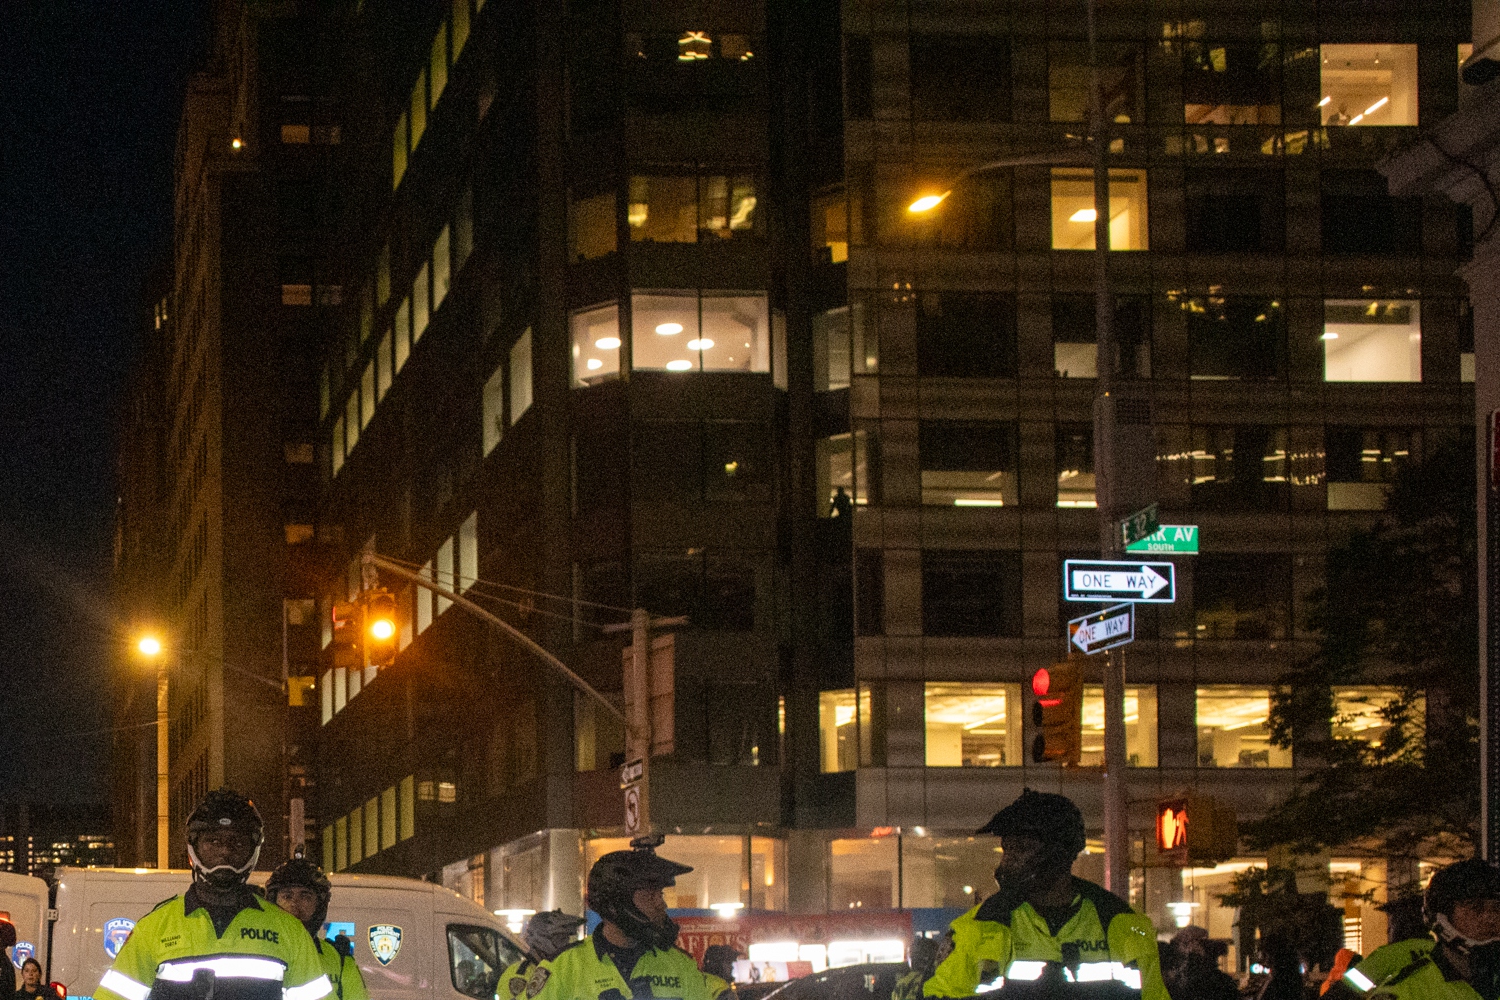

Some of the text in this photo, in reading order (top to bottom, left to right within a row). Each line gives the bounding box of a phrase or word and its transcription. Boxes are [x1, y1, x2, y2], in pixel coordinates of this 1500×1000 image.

[1174, 528, 1194, 542] AV
[1147, 543, 1175, 551] SOUTH
[1082, 573, 1157, 589] ONE WAY
[1078, 615, 1125, 645] ONE WAY
[108, 919, 135, 930] POLICE
[240, 927, 279, 944] POLICE
[649, 975, 682, 989] OLICE
